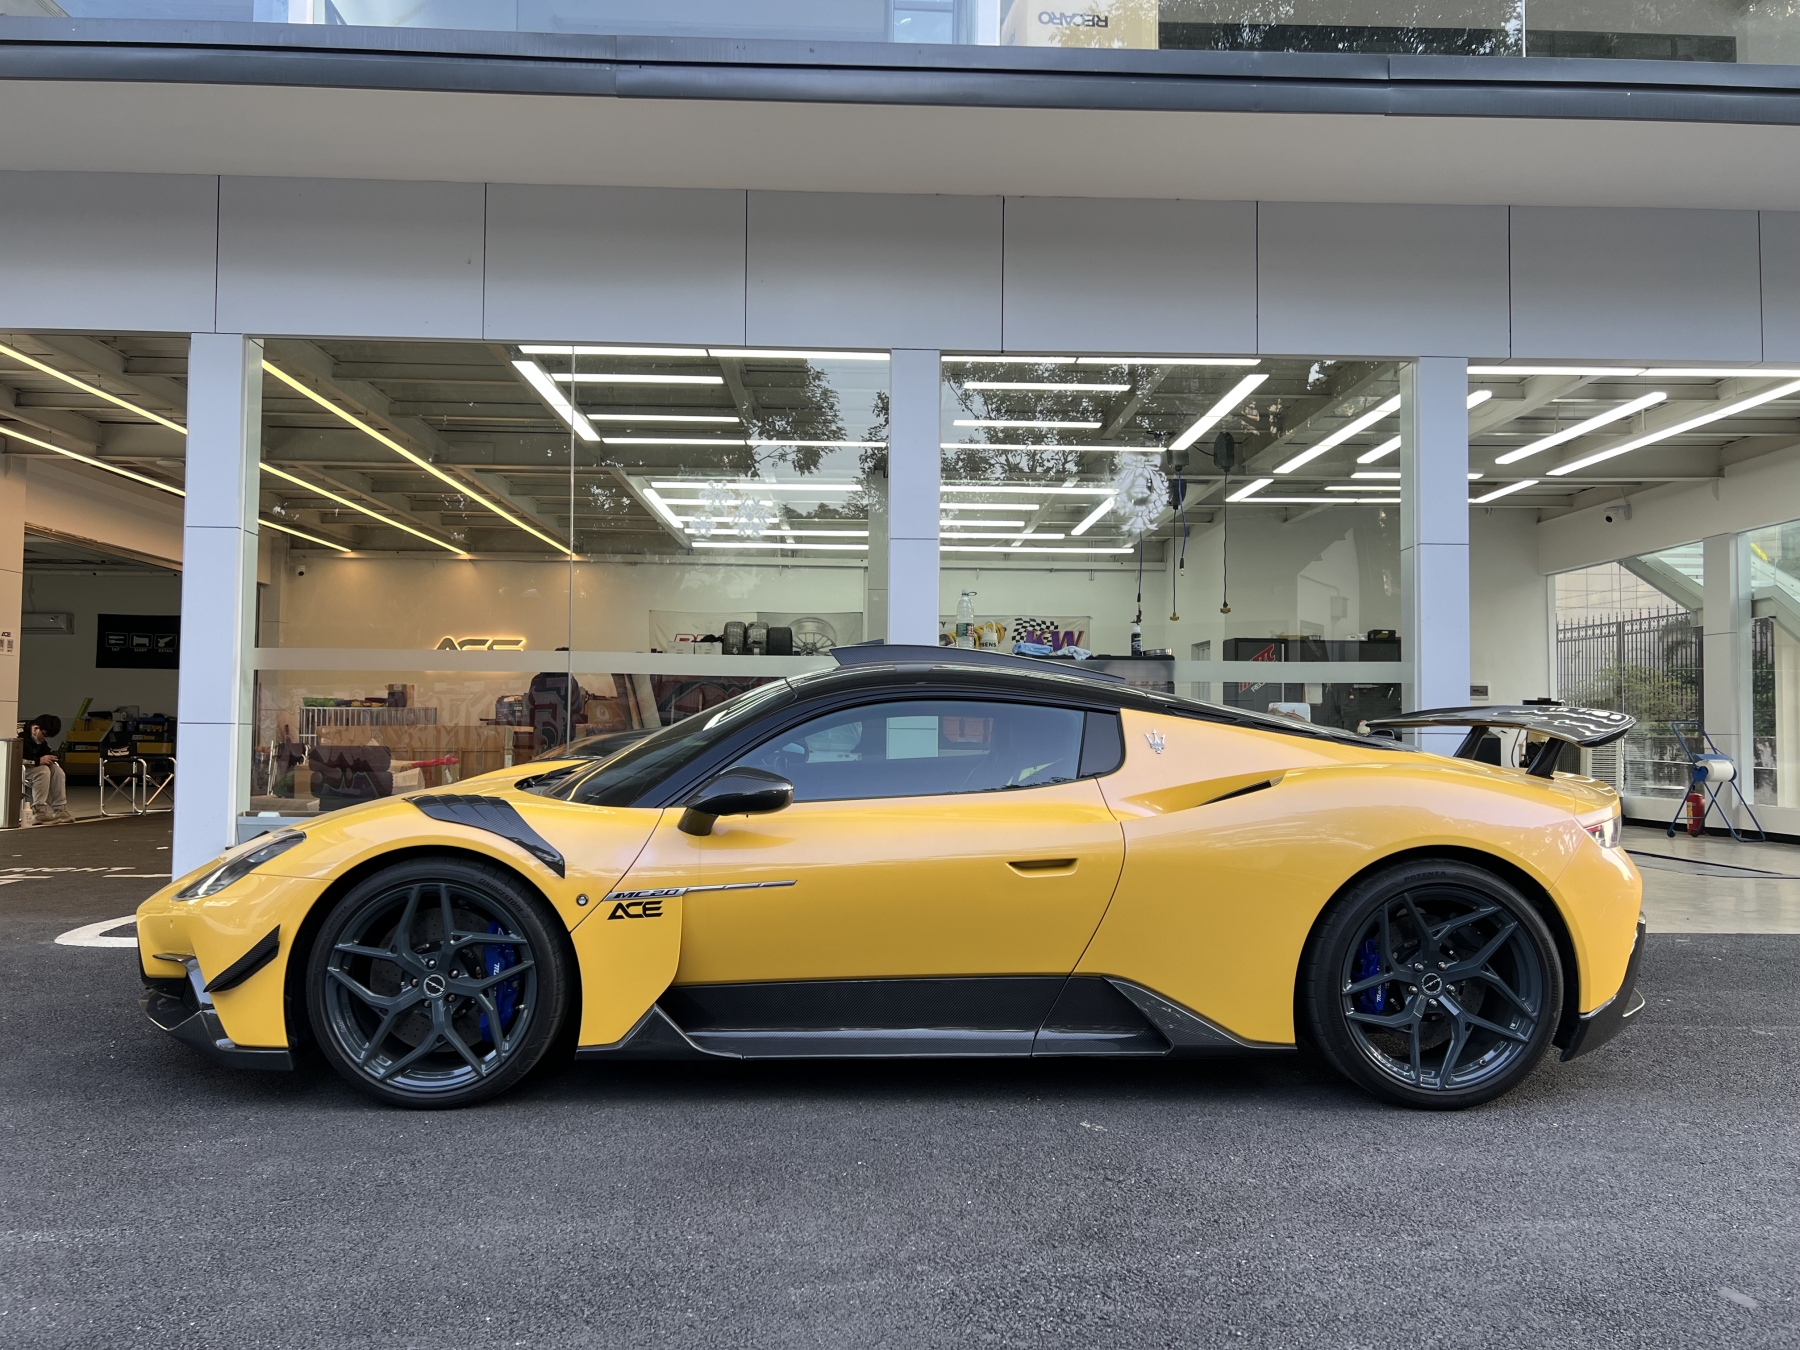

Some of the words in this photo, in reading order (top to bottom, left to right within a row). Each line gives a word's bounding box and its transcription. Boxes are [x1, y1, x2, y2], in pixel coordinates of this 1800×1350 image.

[1038, 11, 1108, 28] RECARO
[1026, 630, 1085, 652] KW
[613, 889, 680, 899] MC20
[607, 900, 663, 920] ACE
